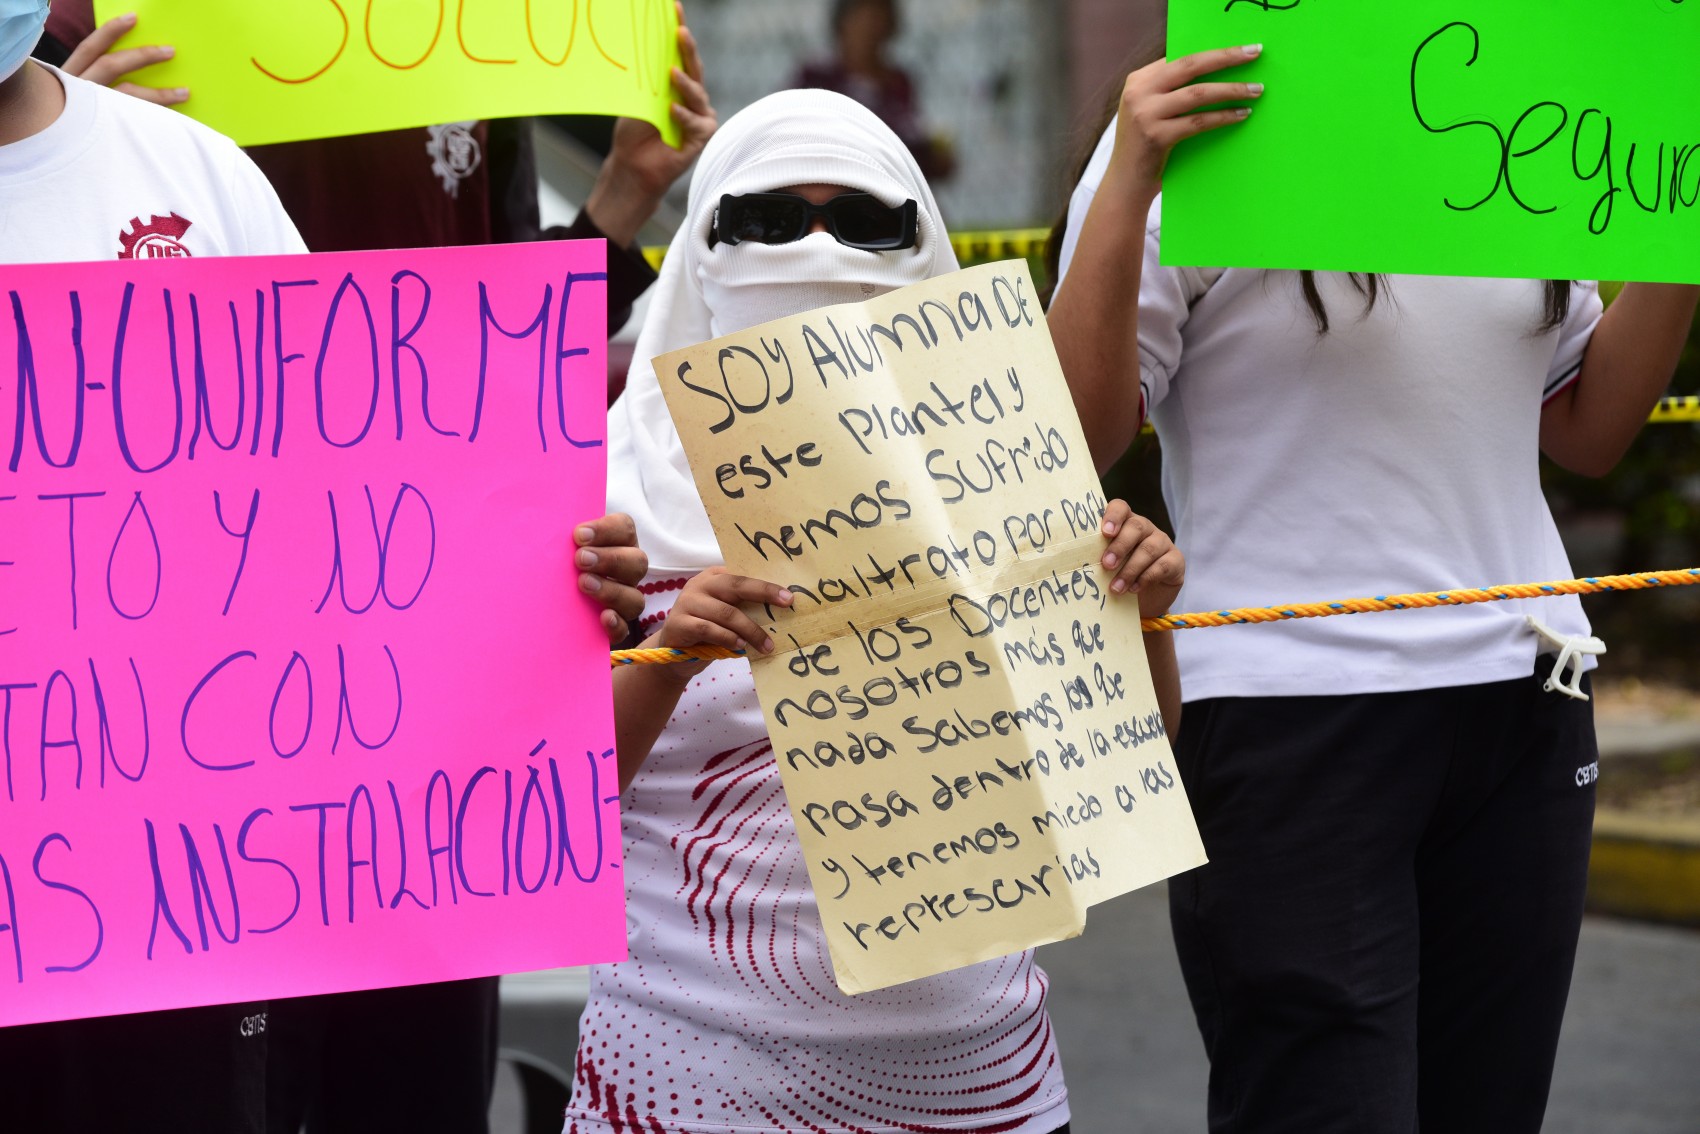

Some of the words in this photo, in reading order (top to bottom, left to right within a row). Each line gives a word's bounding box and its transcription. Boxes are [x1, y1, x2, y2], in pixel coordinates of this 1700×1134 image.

[802, 290, 992, 389] Alumna
[714, 441, 822, 499] este
[213, 488, 259, 615] Y
[314, 482, 436, 615] NO
[734, 479, 911, 563] hemos
[774, 651, 991, 728] nosotros
[788, 633, 840, 677] de
[847, 615, 933, 666] los
[181, 644, 402, 771] CON
[786, 731, 897, 772] nada
[801, 790, 920, 837] pasa
[932, 749, 1050, 811] dentro
[1055, 738, 1085, 771] de
[1086, 728, 1112, 759] la
[821, 857, 851, 900] y
[852, 822, 1020, 887] tenemos
[1031, 793, 1103, 837] miedo
[1115, 784, 1135, 815] a
[1138, 761, 1175, 795] las
